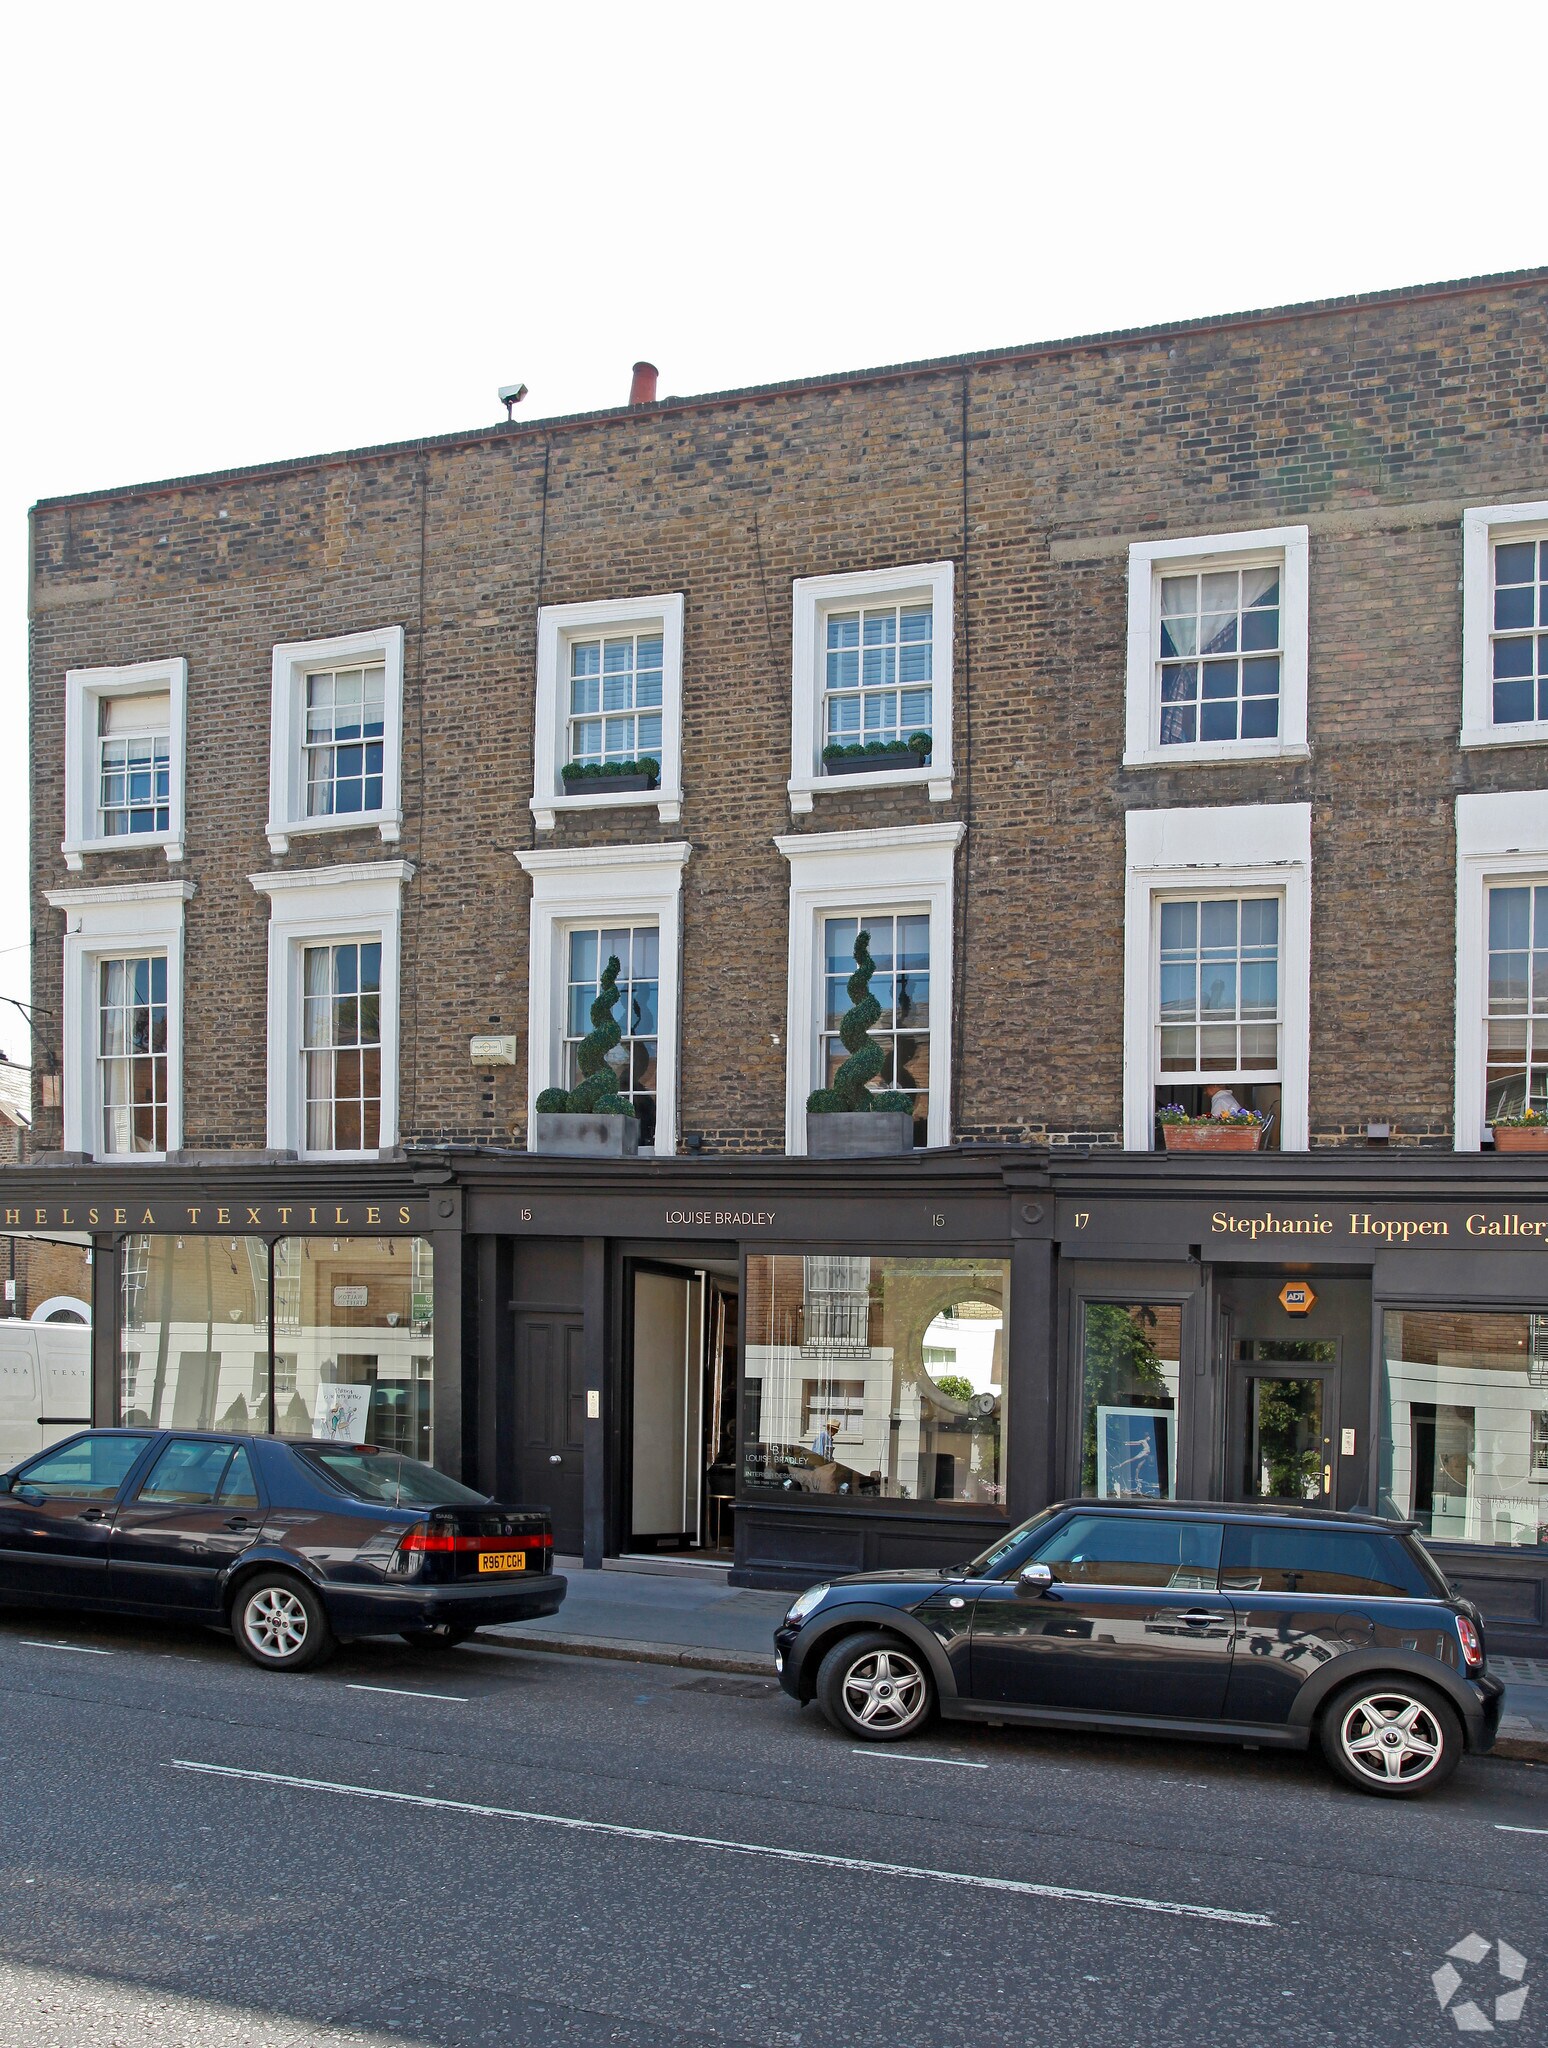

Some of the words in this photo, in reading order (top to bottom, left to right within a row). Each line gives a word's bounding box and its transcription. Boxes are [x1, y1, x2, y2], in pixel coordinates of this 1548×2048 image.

[187, 1206, 411, 1225] TEXTILES
[521, 1208, 532, 1221] 15
[665, 1211, 712, 1225] LOUISE
[715, 1212, 776, 1226] BRADLEY
[932, 1213, 946, 1227] 15
[1074, 1213, 1090, 1230] 17
[1211, 1211, 1333, 1239] Stephanie
[1349, 1213, 1450, 1242] Hoppen
[1286, 1292, 1305, 1301] ADT
[745, 1454, 772, 1463] LOUISE
[483, 1555, 505, 1569] R967
[506, 1554, 523, 1568] CGH
